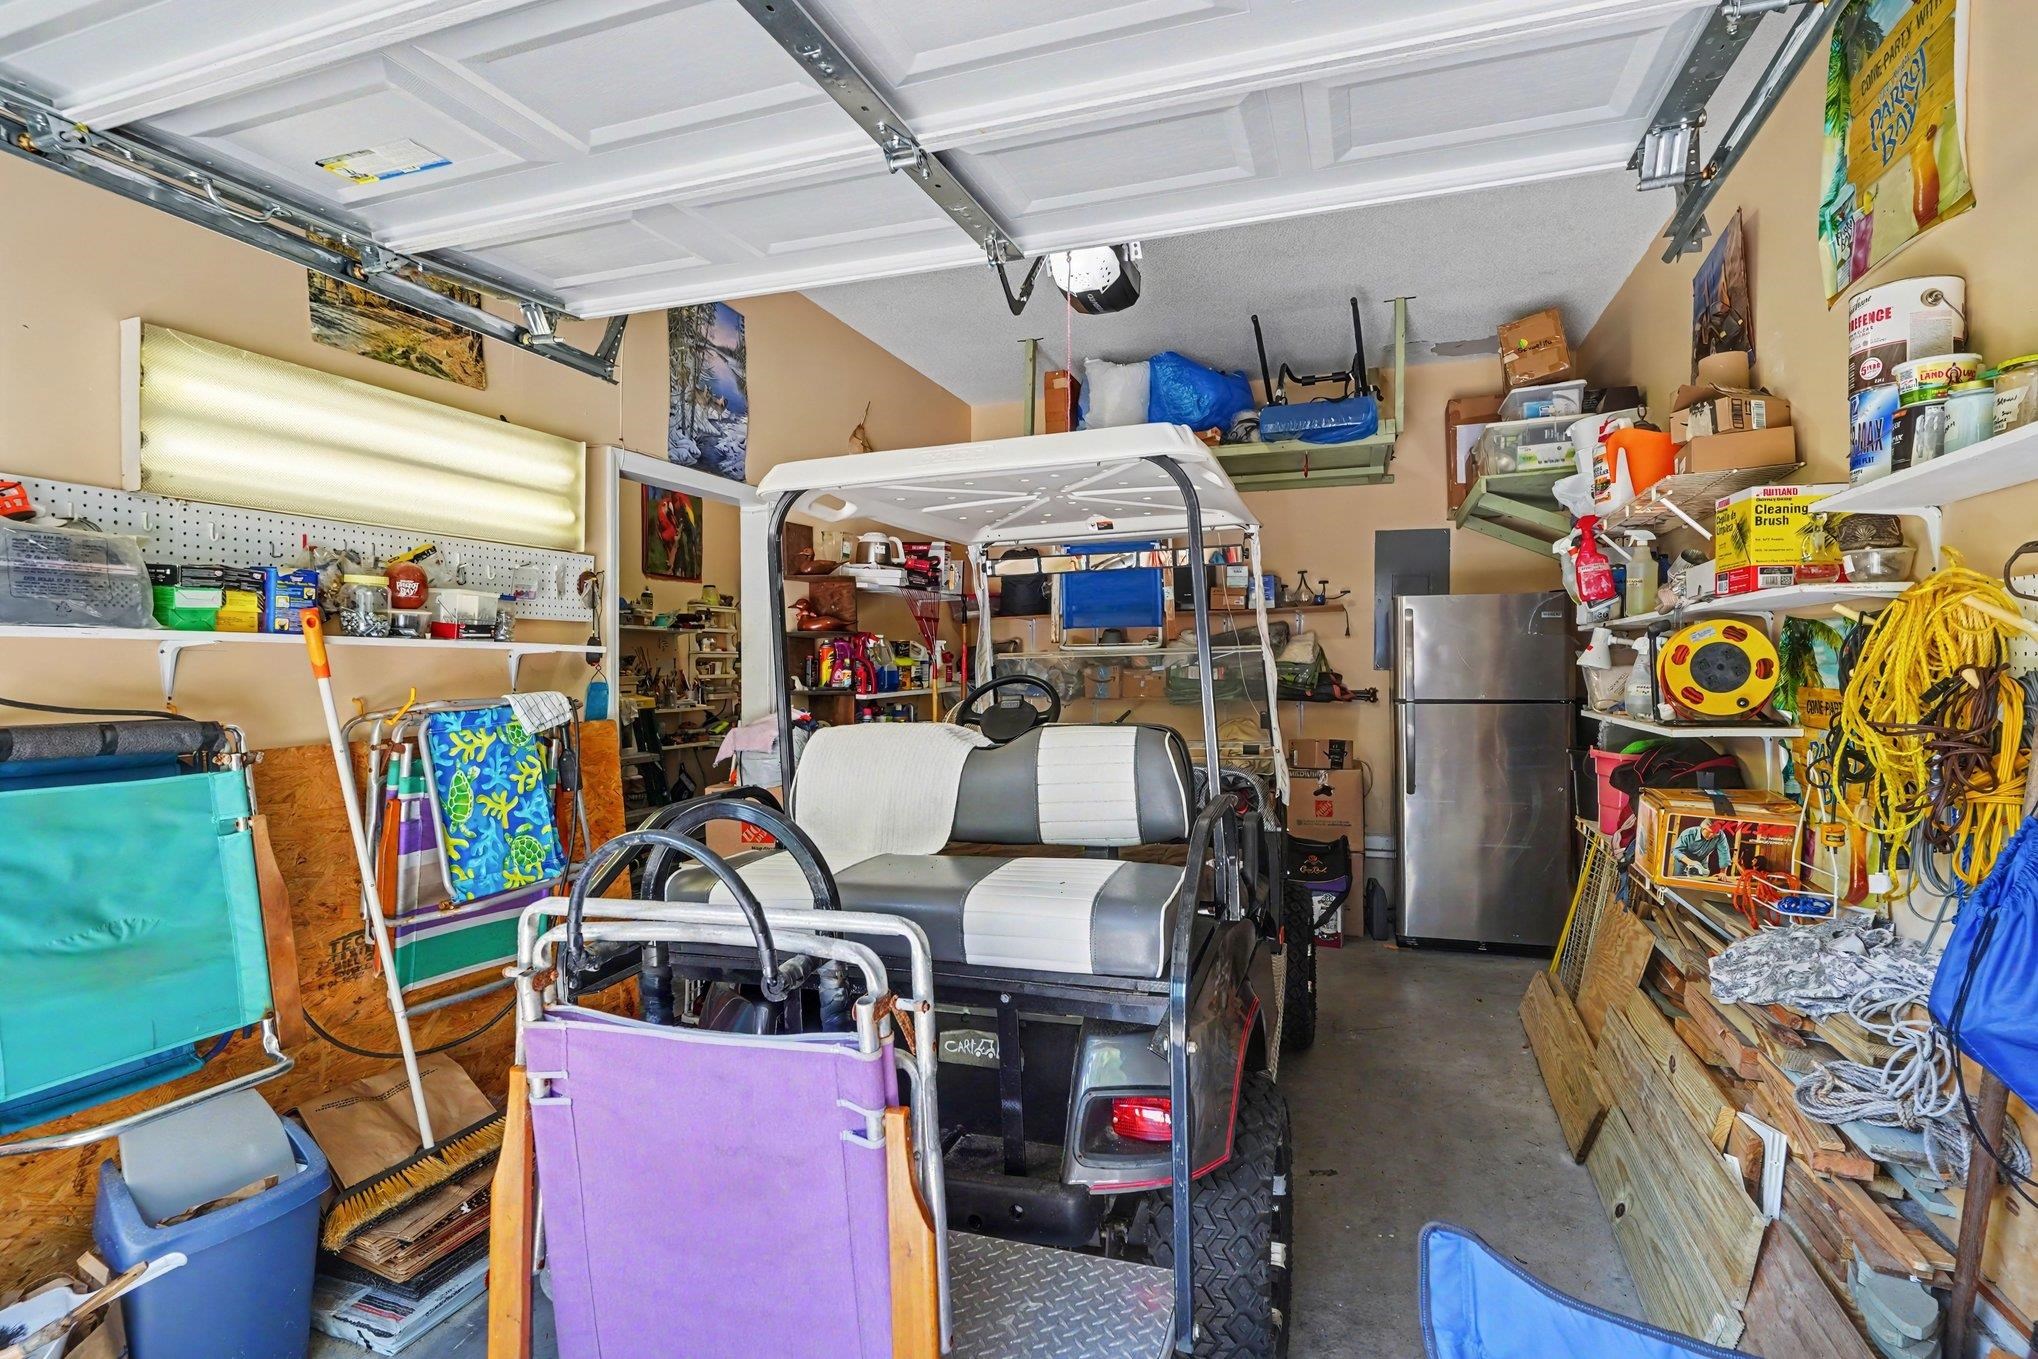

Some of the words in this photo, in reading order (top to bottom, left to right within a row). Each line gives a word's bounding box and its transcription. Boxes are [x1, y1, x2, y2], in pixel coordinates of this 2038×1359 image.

[1883, 21, 1912, 70] PARTY
[1869, 37, 1928, 152] PARROT
[1881, 82, 1920, 168] BAY
[1920, 370, 1944, 381] LAND
[1763, 487, 1799, 497] RUTLAND
[1754, 503, 1809, 515] Cleaning
[1754, 515, 1790, 527] Brush
